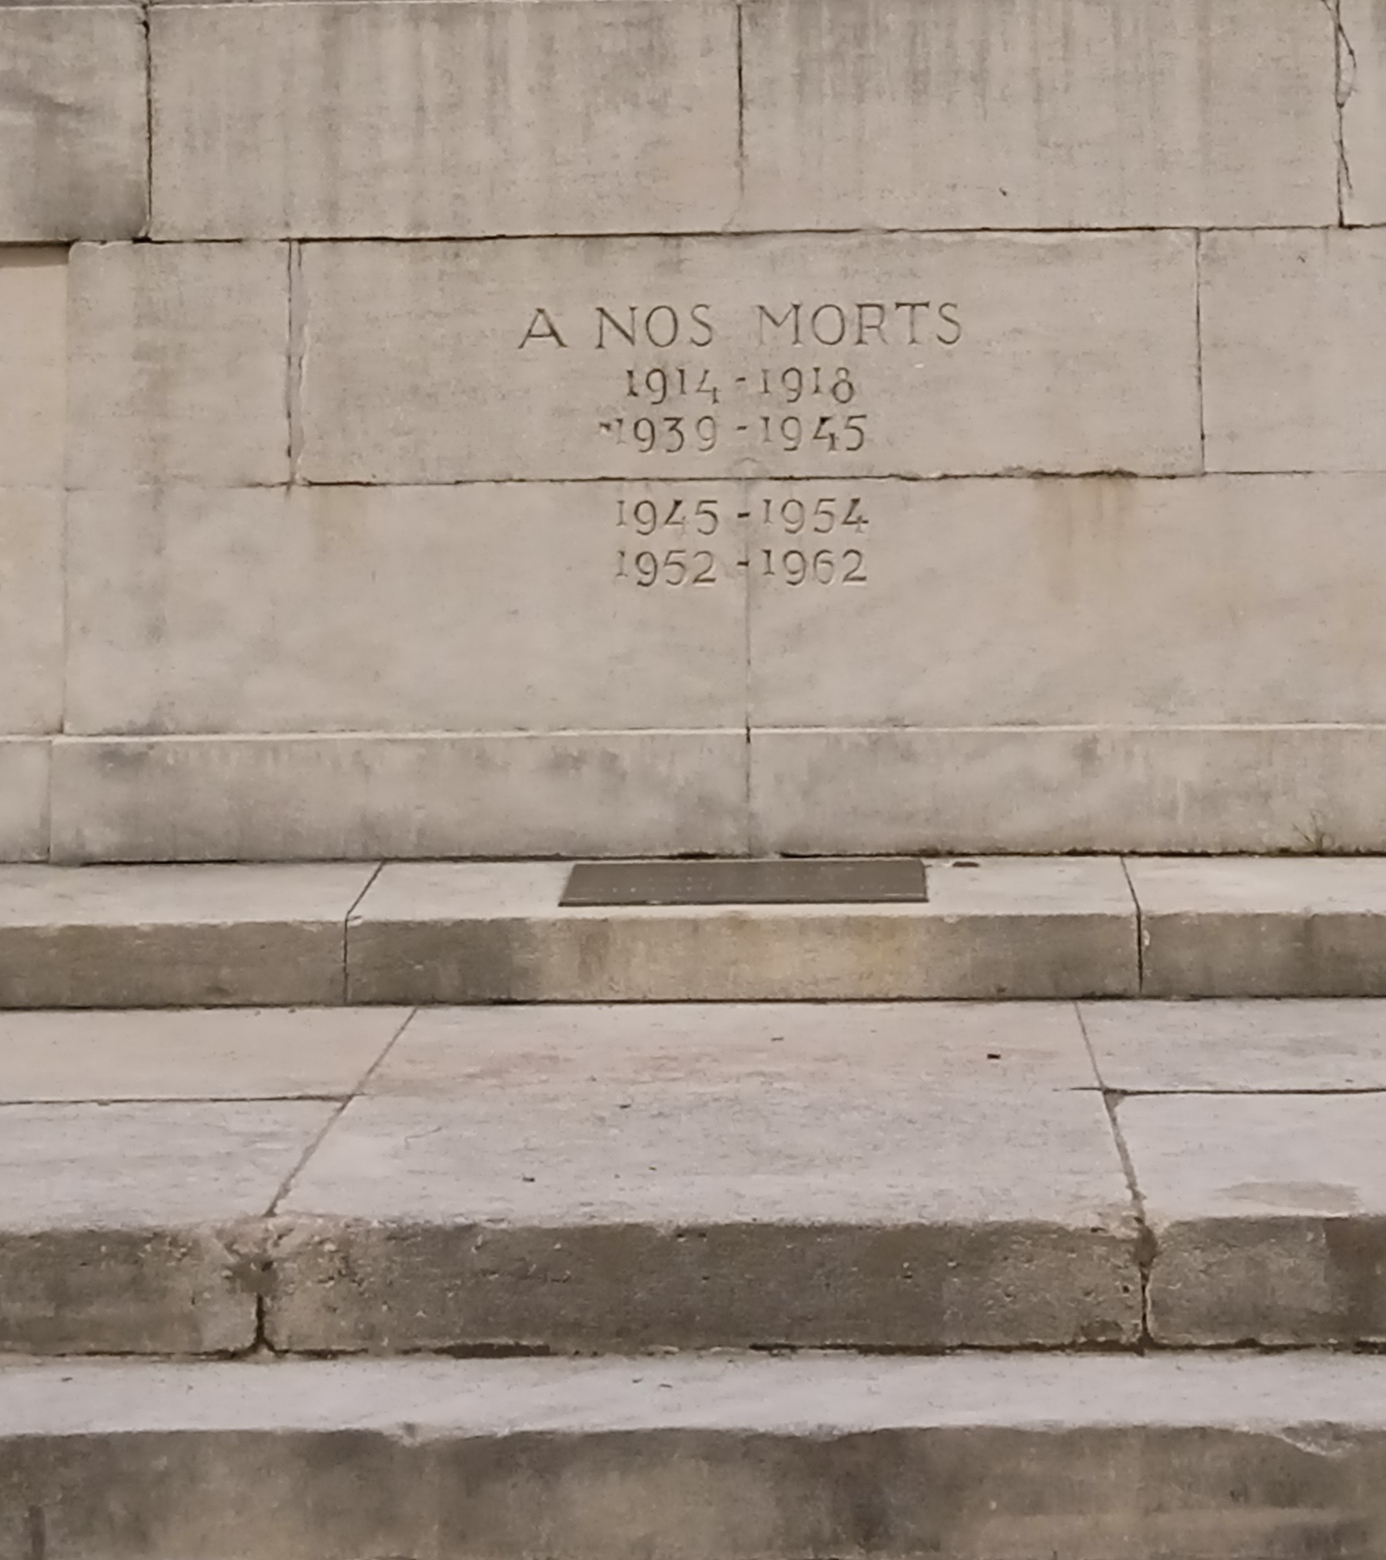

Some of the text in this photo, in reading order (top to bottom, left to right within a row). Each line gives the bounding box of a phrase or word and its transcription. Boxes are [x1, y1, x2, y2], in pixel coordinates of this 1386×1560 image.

[518, 300, 963, 350] A NOS MORTS
